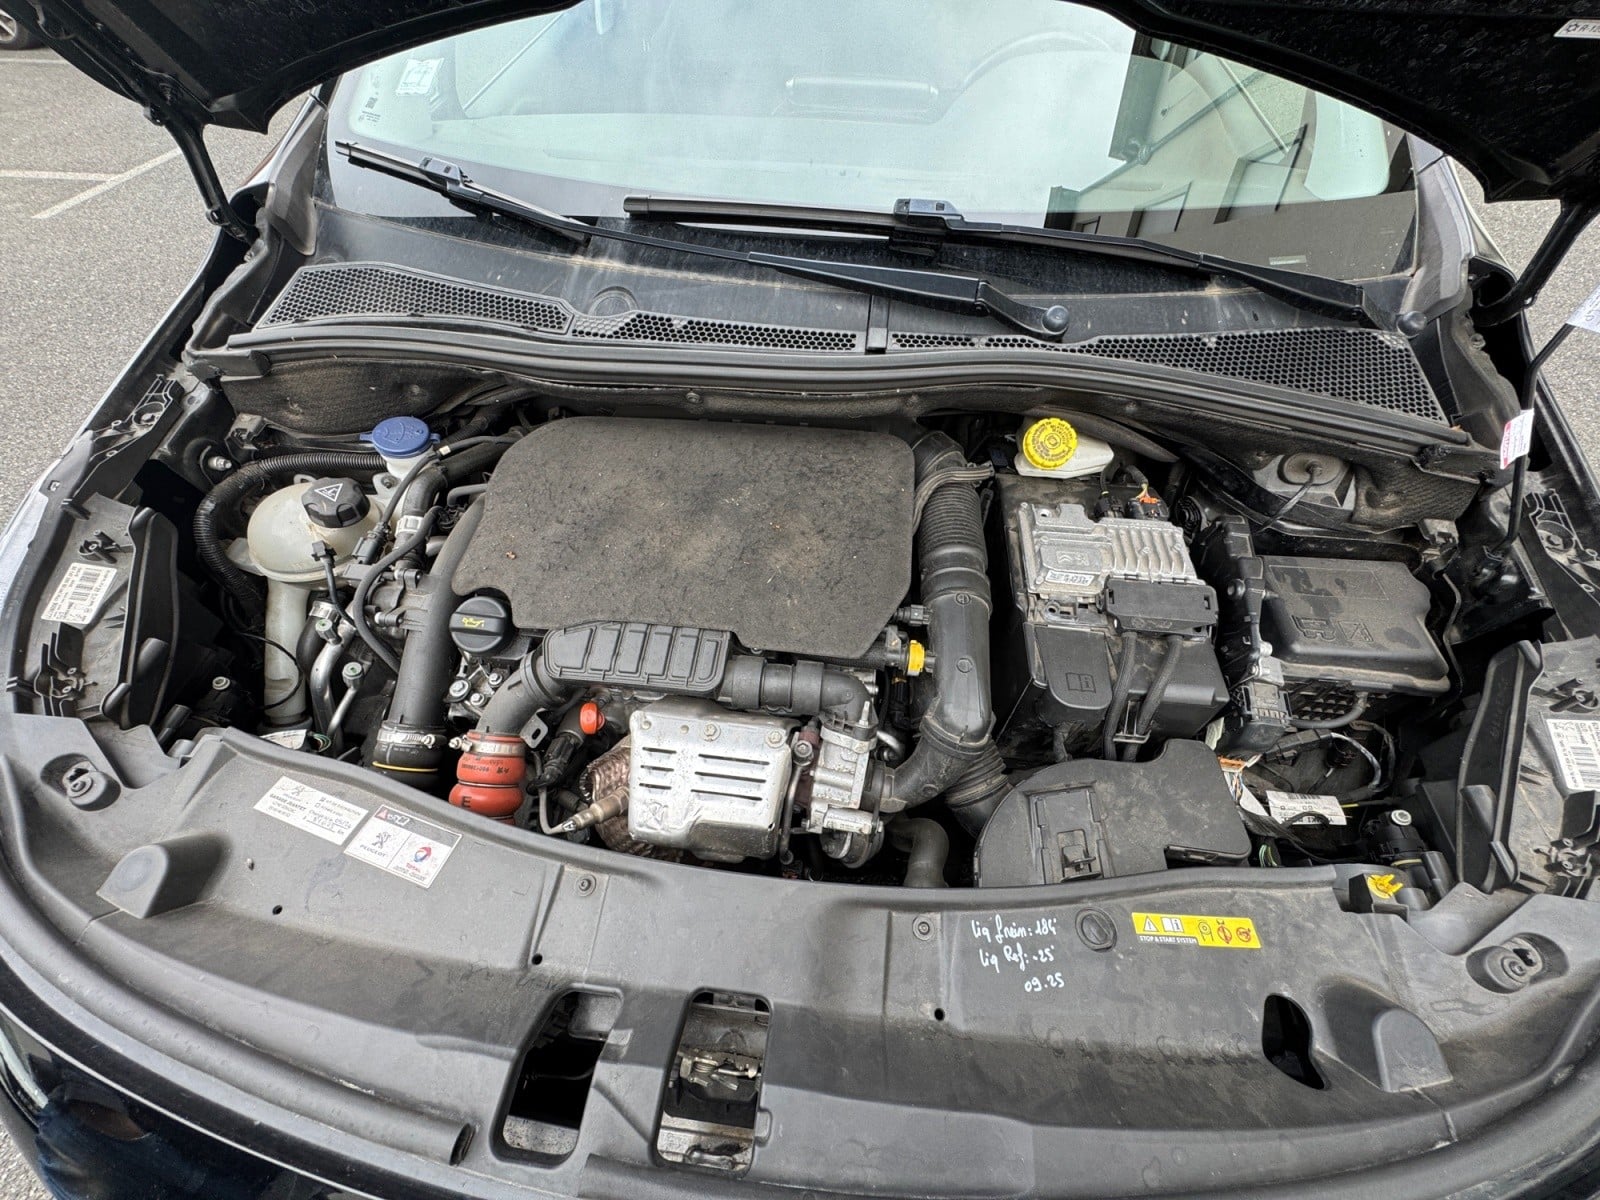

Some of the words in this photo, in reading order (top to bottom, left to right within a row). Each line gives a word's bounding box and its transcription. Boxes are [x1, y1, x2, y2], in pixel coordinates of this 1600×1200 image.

[462, 796, 472, 807] E
[360, 844, 387, 857] PEUGEOT
[406, 862, 422, 874] TOTAL
[1024, 971, 1065, 992] 09.25
